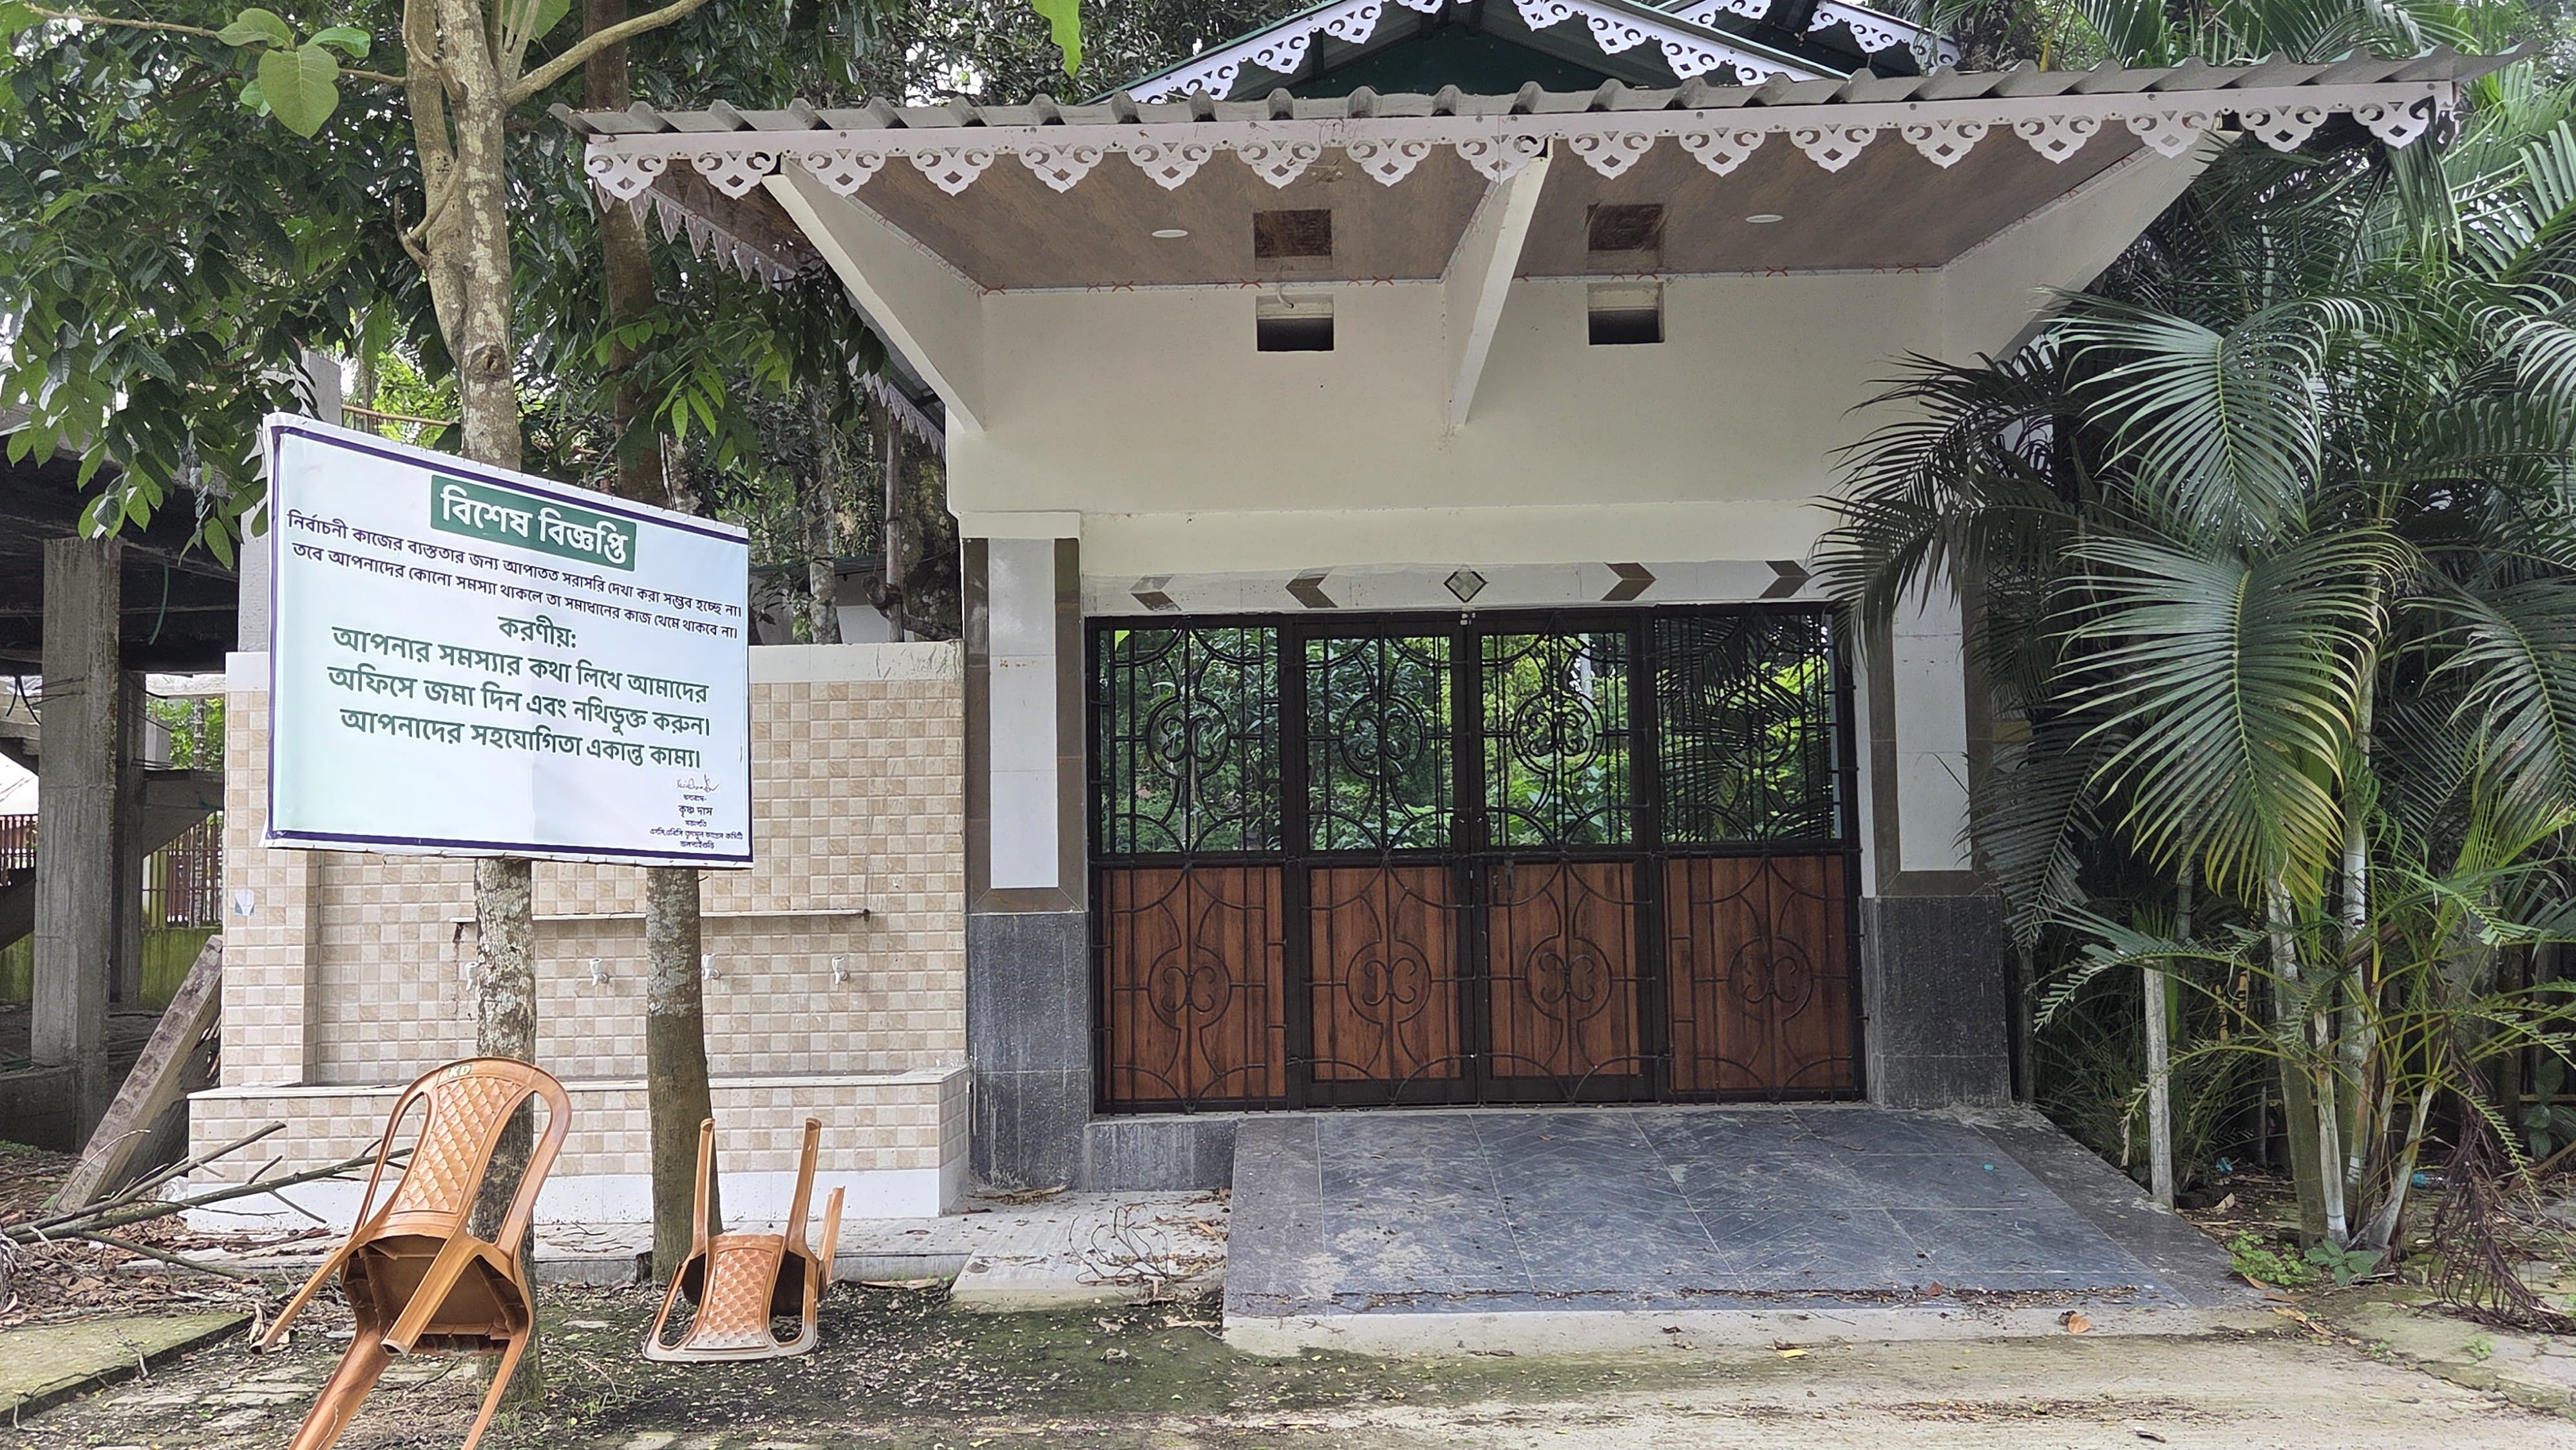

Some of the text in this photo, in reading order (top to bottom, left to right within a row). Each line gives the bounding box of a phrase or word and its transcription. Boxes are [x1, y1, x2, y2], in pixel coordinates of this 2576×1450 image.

[286, 509, 349, 539] নির্বাচনী
[351, 528, 404, 551] কাজের
[406, 540, 466, 564] ব্যস্ততার
[468, 552, 500, 570] জন্য
[502, 560, 560, 581] আপাতত
[561, 572, 607, 592] সরাসরি
[608, 582, 634, 598] দেখা
[636, 587, 661, 603] করা
[663, 592, 694, 610] সম্ভব
[695, 599, 723, 616] হচ্ছে
[440, 484, 629, 564] বিশেষ বিজ্ঞপ্তি
[291, 542, 325, 561] তবে
[327, 547, 406, 578] আপনাদের
[408, 567, 453, 587] কোনো
[455, 576, 498, 596] সমস্যা
[500, 584, 544, 603] থাকলে
[545, 593, 562, 608] তা
[564, 597, 621, 619] সমাধানের
[623, 608, 652, 625] কাজ
[682, 619, 719, 636] থাকবে
[327, 663, 418, 699] অফিসে
[423, 680, 476, 707] জমা
[480, 681, 523, 712] দিন
[526, 695, 567, 719] এবং
[572, 695, 649, 737] নথিভুক্ত
[331, 626, 710, 703] আপনার সমস্যার কথা লিখে আমাদের
[339, 708, 466, 744] আপনাদের
[470, 724, 583, 757] সহযোগিতা
[586, 739, 645, 767] একান্ত
[448, 1064, 472, 1078] KD
